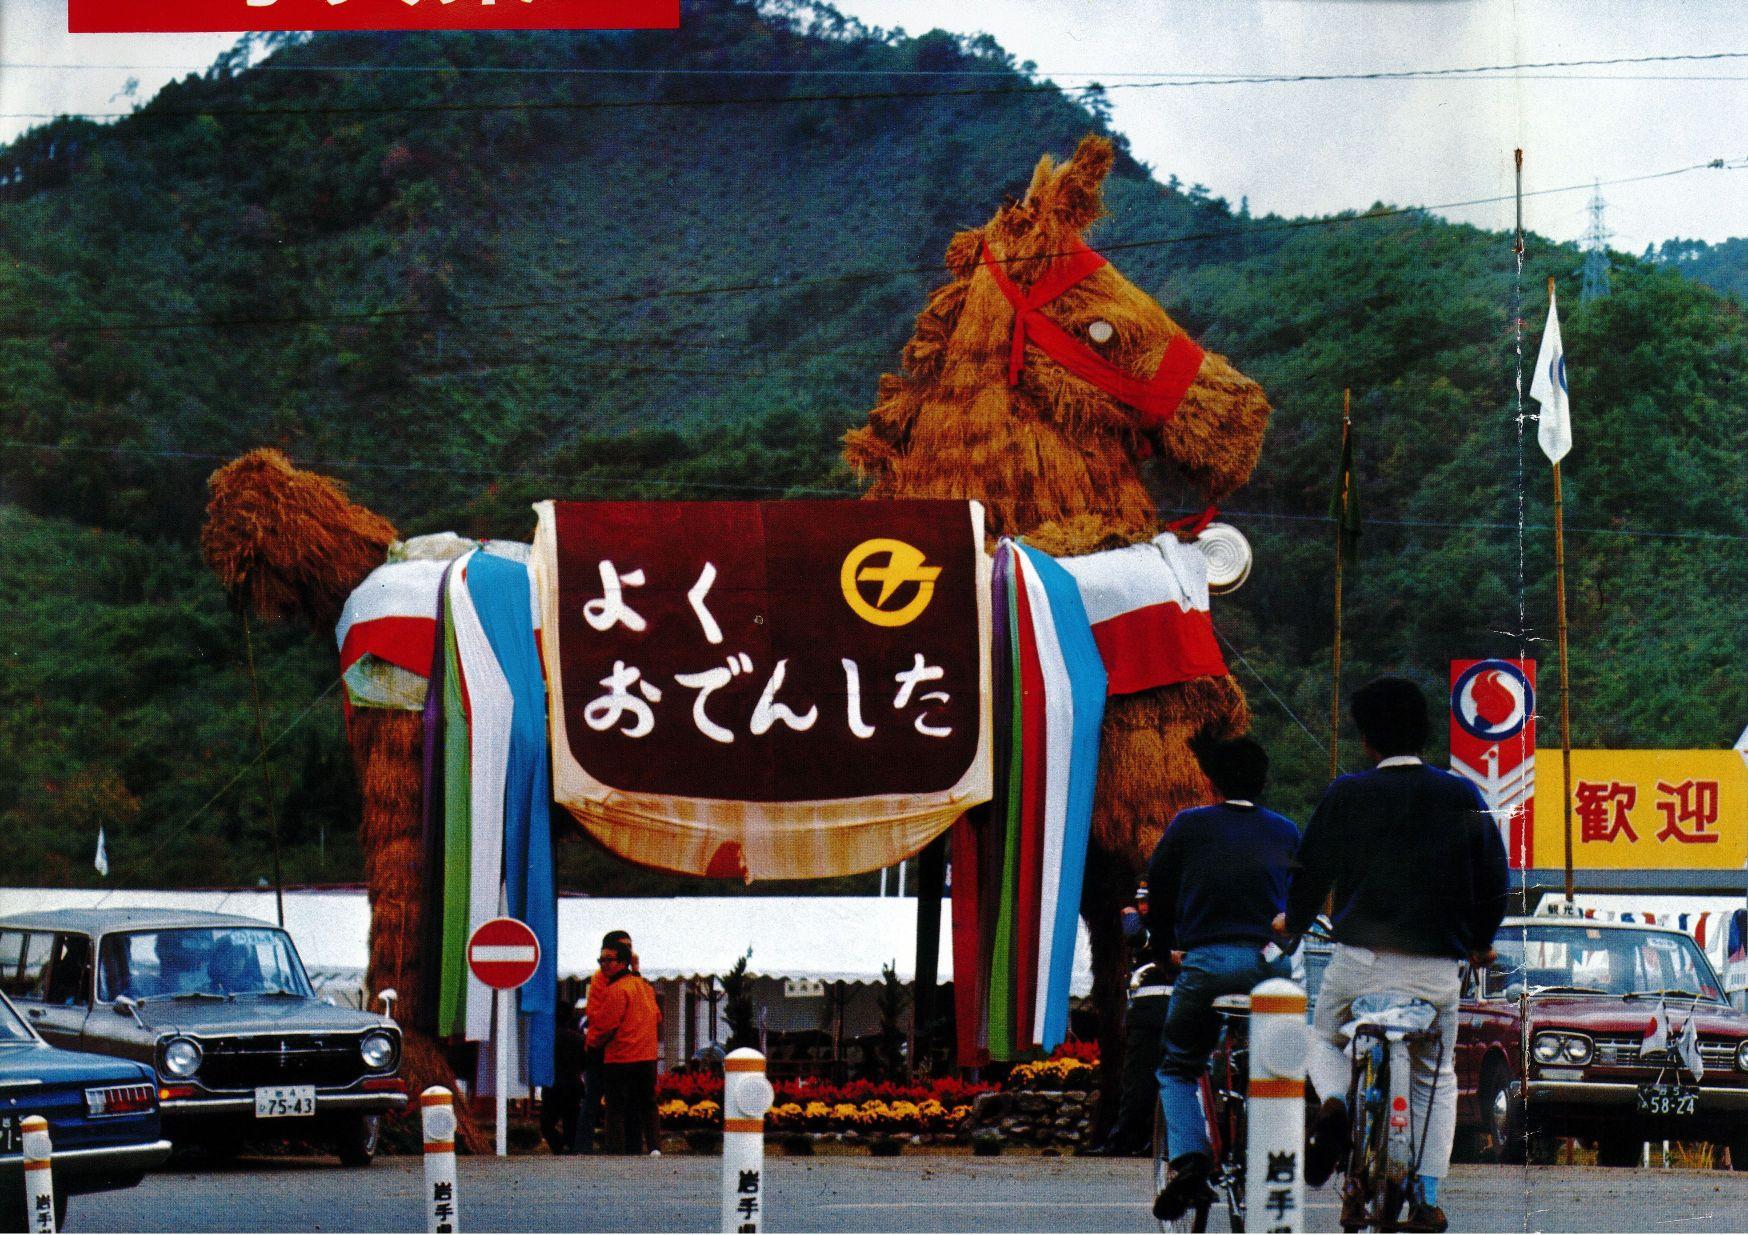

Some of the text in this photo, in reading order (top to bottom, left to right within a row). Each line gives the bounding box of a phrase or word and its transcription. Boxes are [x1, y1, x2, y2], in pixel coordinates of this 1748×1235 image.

[583, 559, 723, 644] よく
[584, 652, 953, 743] おでんした
[1575, 780, 1720, 844] 歓迎
[268, 1098, 312, 1115] 75-43
[1651, 1096, 1696, 1115] 58-24
[36, 1195, 52, 1233] 岩手
[1265, 1151, 1295, 1233] 岩手
